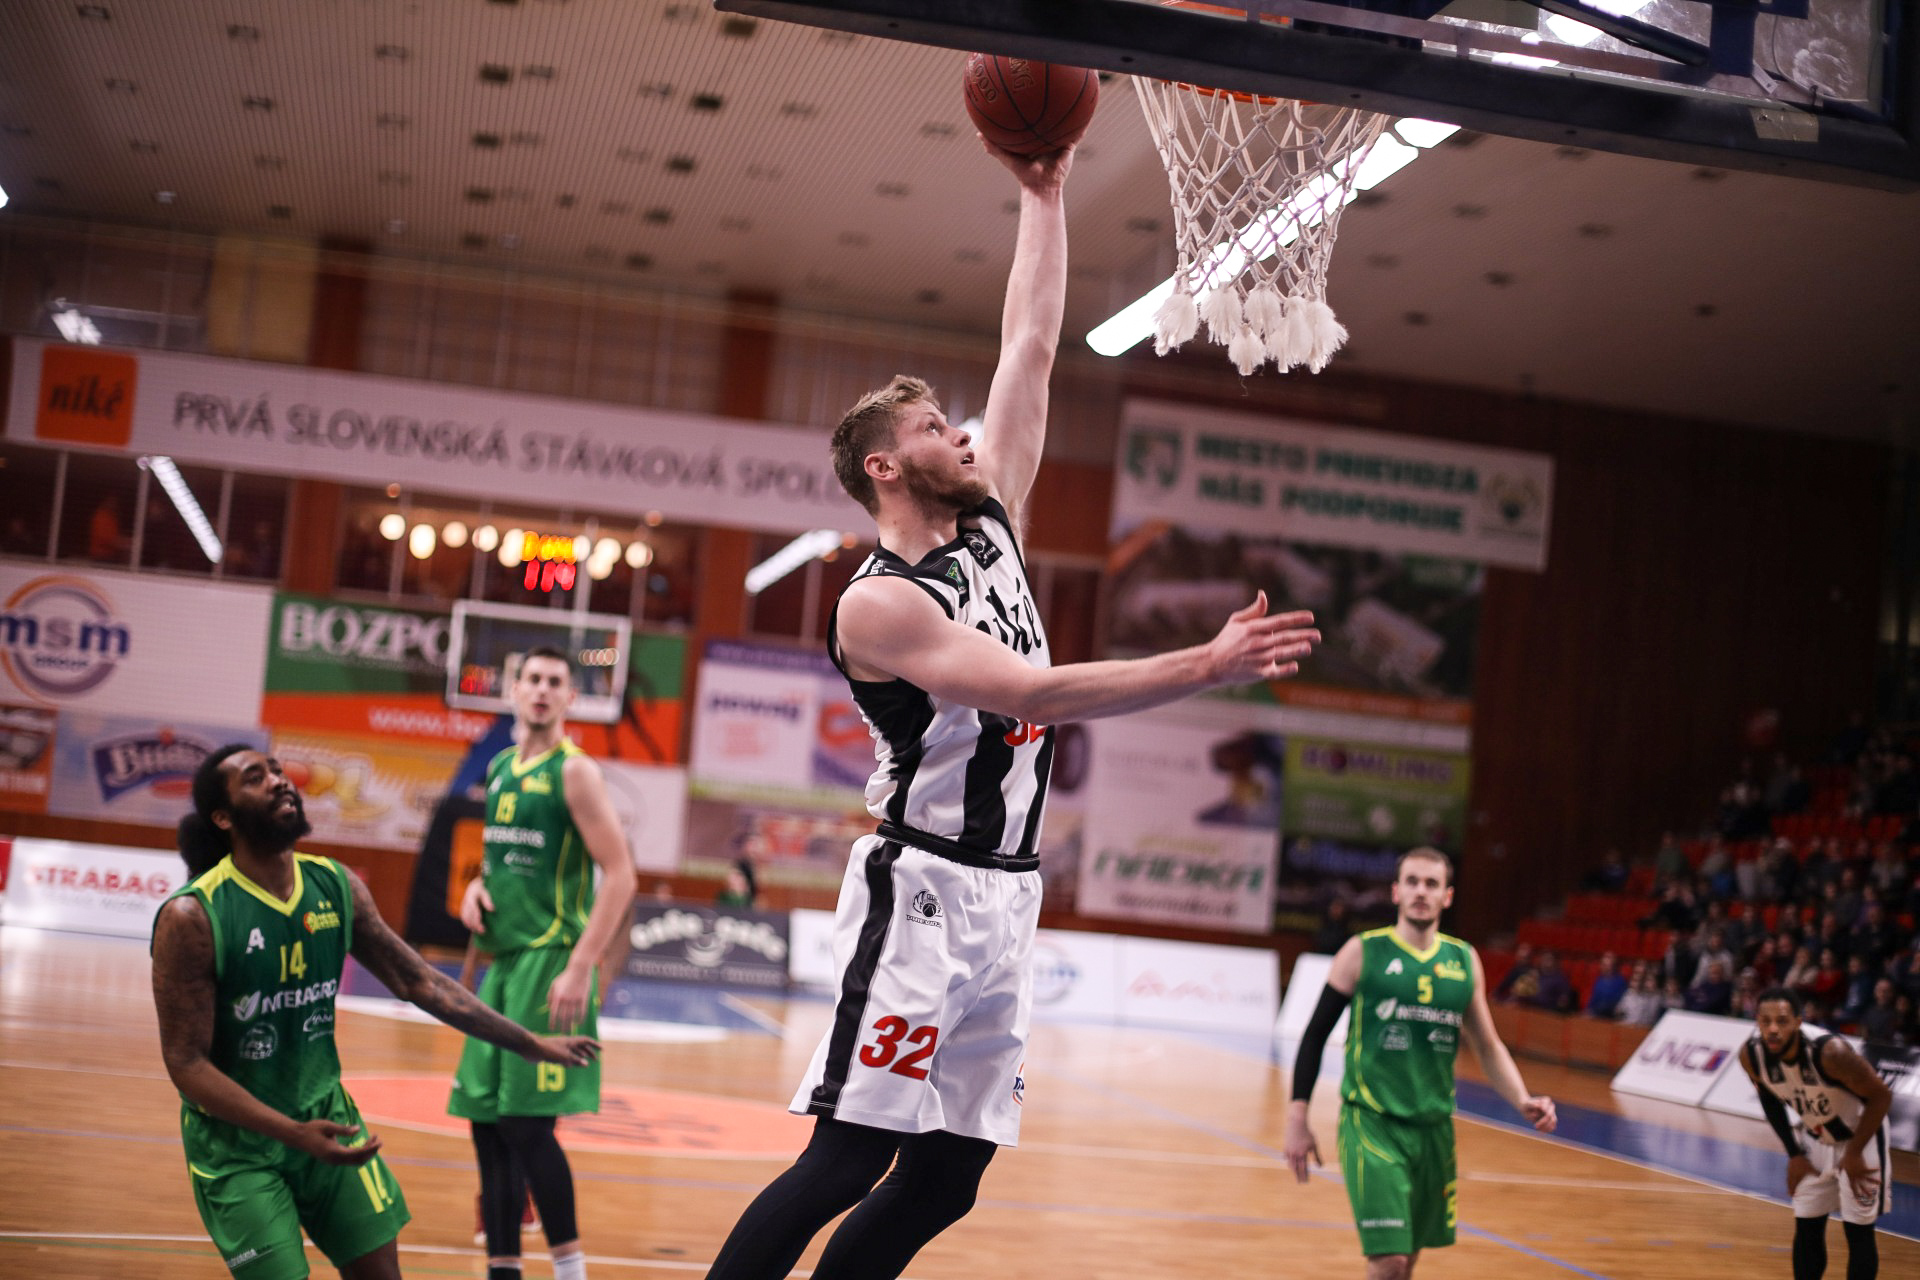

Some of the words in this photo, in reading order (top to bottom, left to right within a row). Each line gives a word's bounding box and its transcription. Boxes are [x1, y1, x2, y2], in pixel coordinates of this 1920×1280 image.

[172, 391, 274, 437] PRVÁ
[286, 404, 509, 467] SLOVENSKÁ
[279, 940, 307, 983] 14
[1417, 974, 1433, 1004] 5
[859, 1014, 939, 1082] 32
